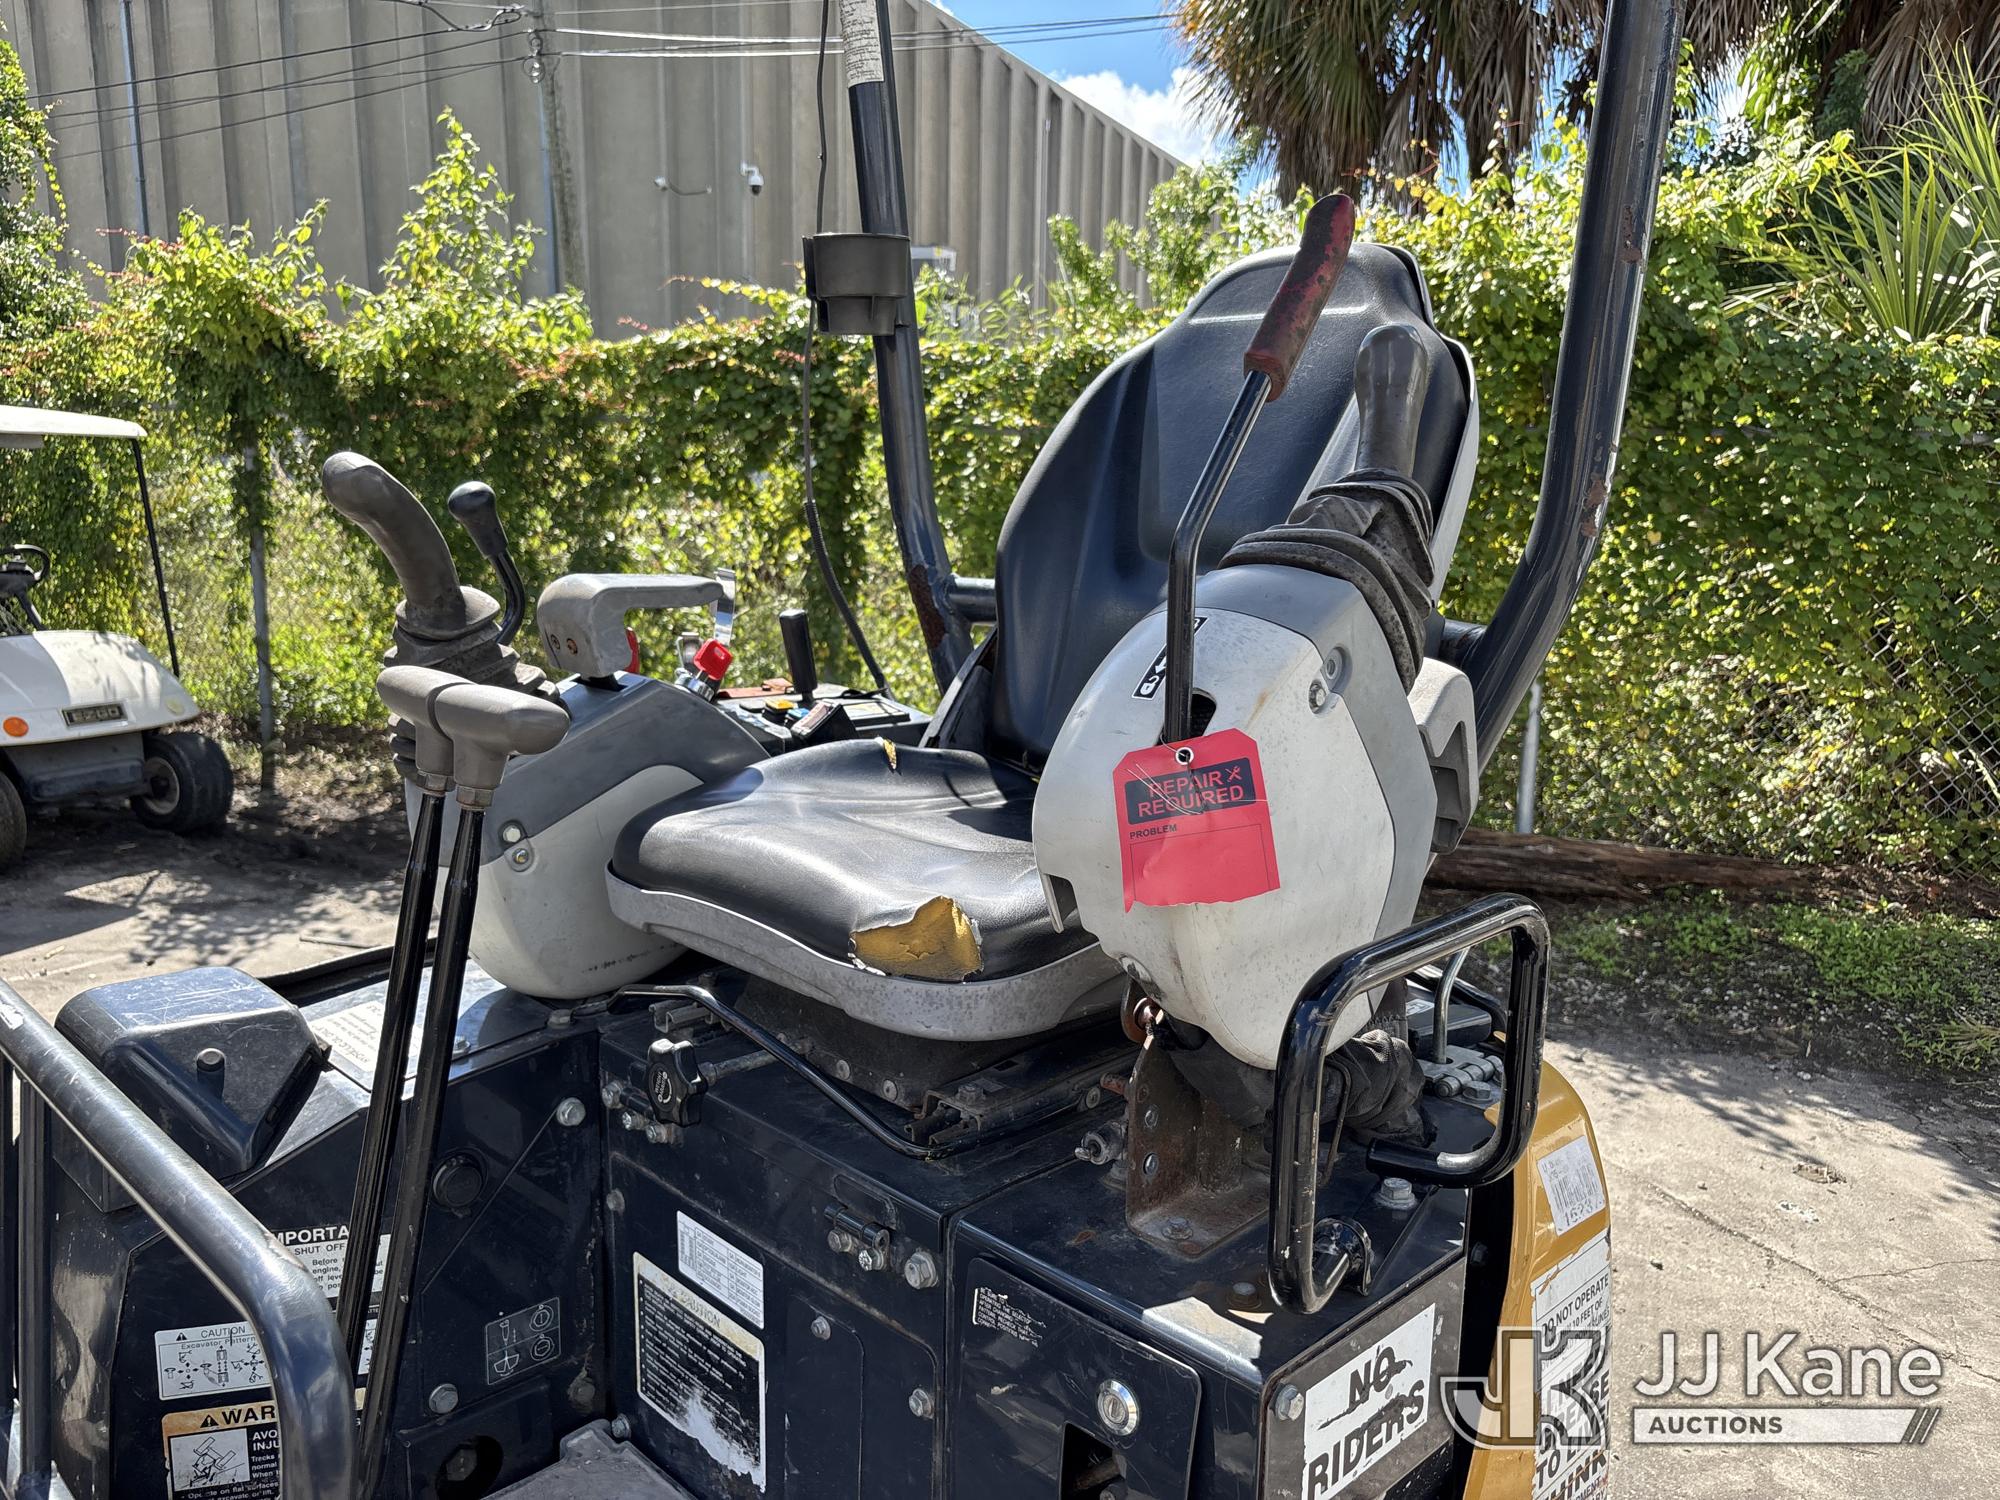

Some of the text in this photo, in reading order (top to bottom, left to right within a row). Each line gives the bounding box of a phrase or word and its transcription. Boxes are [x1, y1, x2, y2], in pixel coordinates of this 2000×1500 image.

[1150, 770, 1222, 797] REPAIR
[1138, 785, 1244, 817] REQUIRED
[1129, 824, 1178, 840] PROBLEM
[294, 1242, 345, 1256] SHUT OFF
[312, 1258, 338, 1266] Before
[1556, 1302, 1574, 1327] NOT
[1574, 1273, 1609, 1311] OPERATE
[1580, 1303, 1594, 1323] FEET
[201, 1326, 246, 1339] CAUTION
[181, 1340, 222, 1350] Excavator
[1348, 1346, 1396, 1409] NO
[1307, 1380, 1424, 1500] RIDERS
